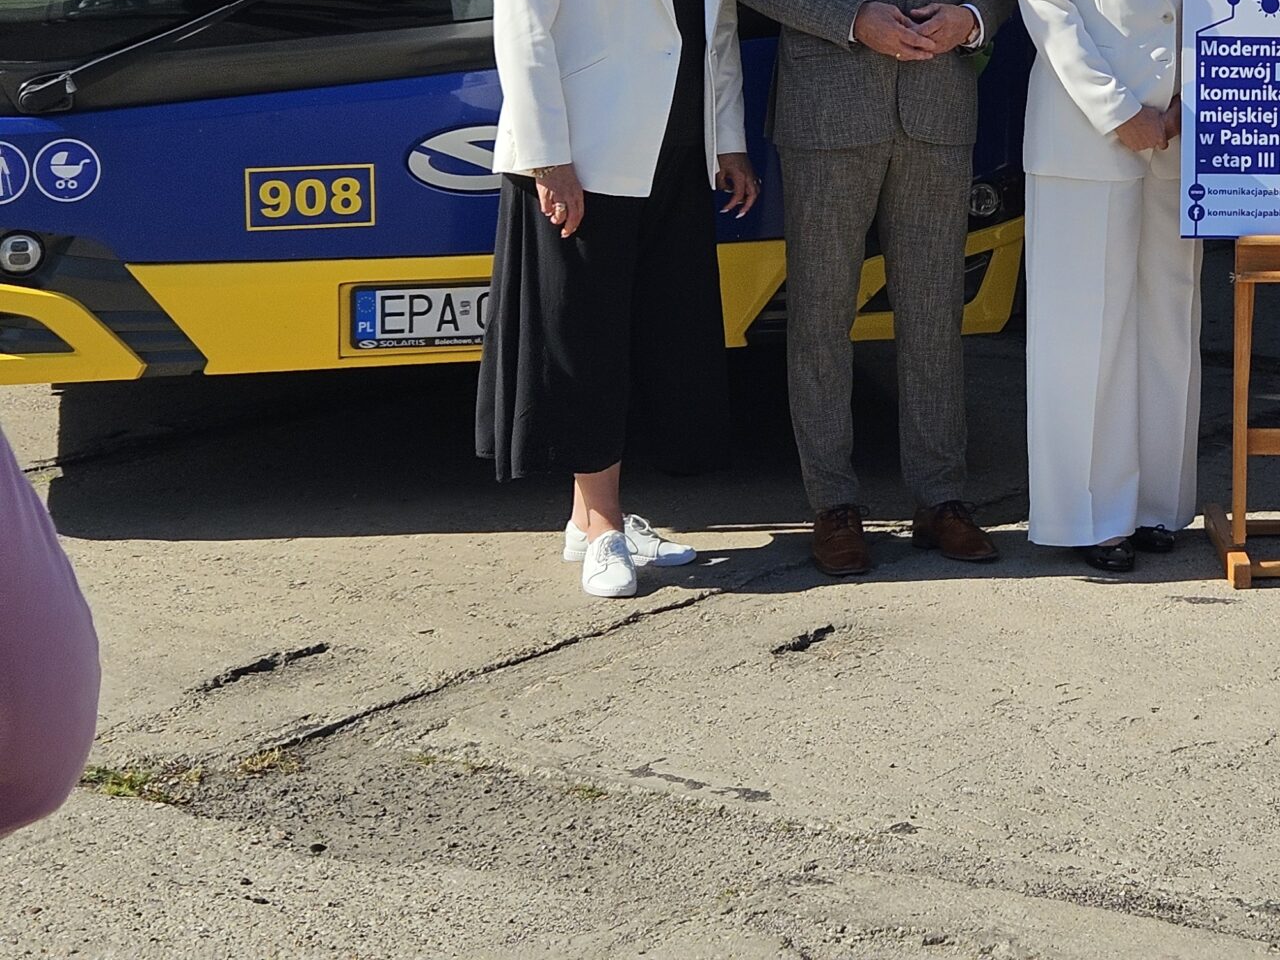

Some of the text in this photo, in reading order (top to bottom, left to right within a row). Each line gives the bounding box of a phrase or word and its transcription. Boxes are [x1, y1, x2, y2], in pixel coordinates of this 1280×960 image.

[1200, 62, 1271, 83] i rozwój
[1200, 107, 1279, 127] miejskiej
[1200, 132, 1215, 145] w
[1212, 153, 1252, 172] etap
[1257, 152, 1275, 168] III
[258, 178, 363, 218] 908
[380, 292, 460, 334] EPA
[358, 321, 374, 333] PL
[379, 339, 426, 347] SOLARIS
